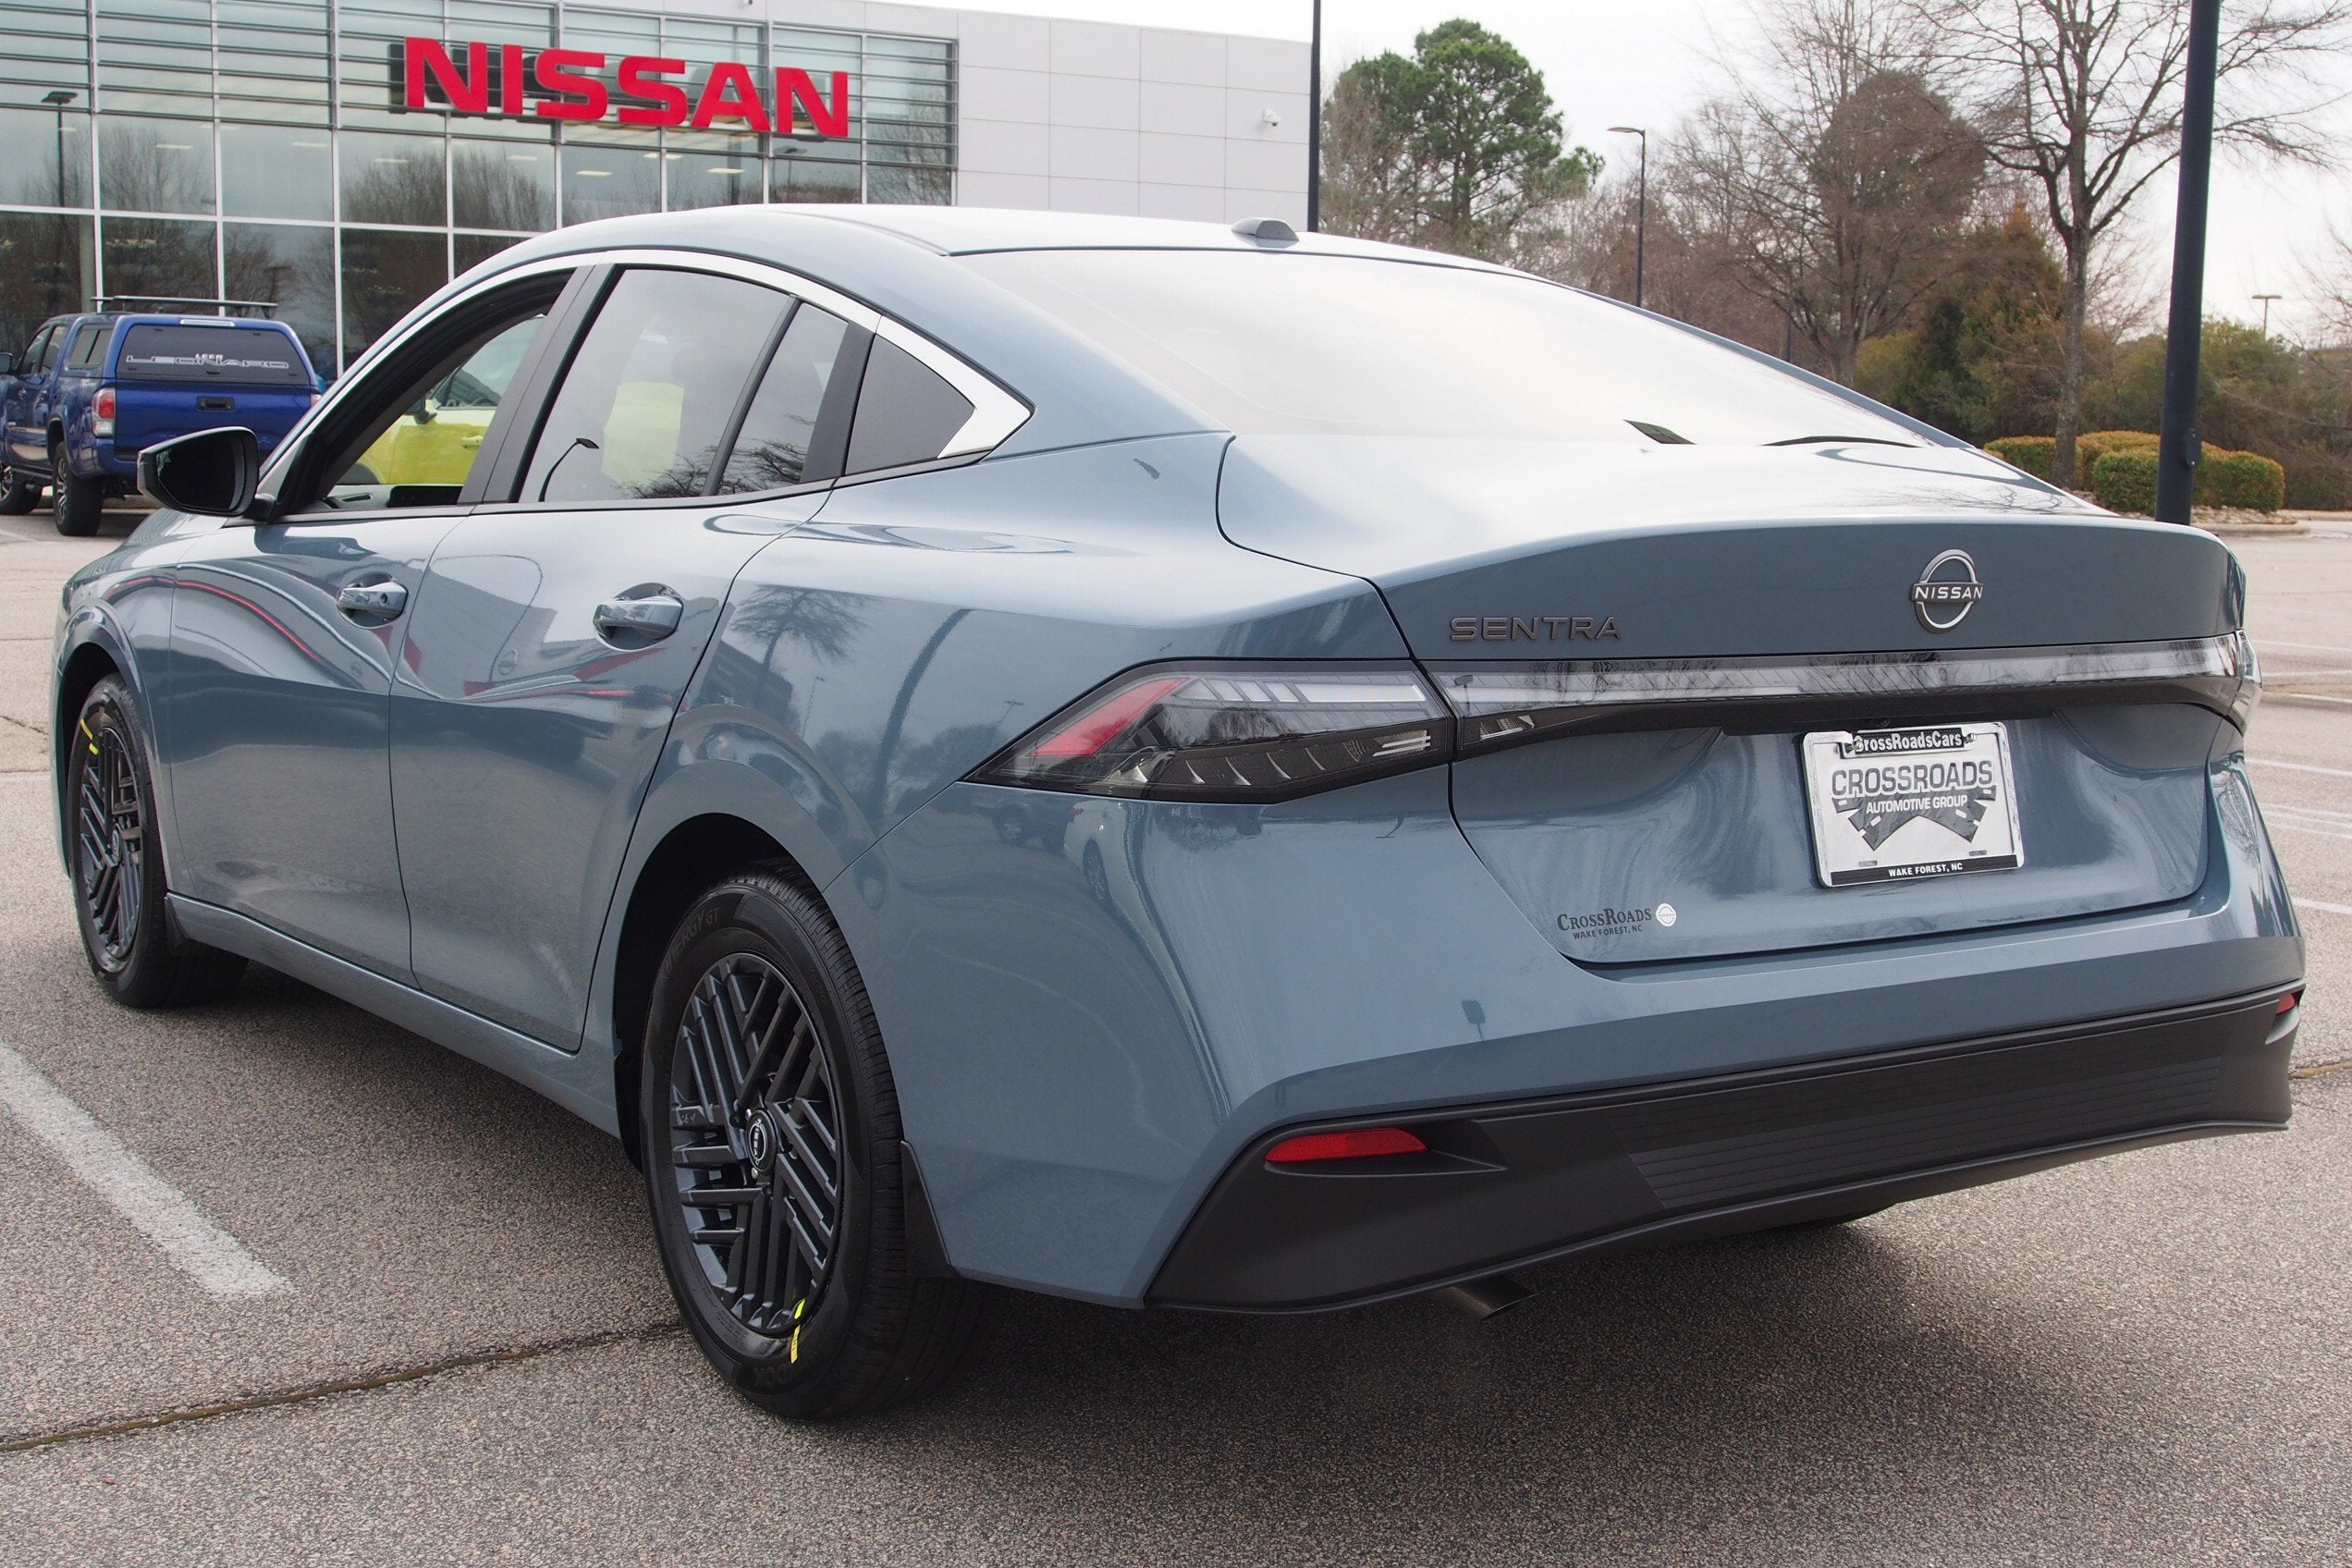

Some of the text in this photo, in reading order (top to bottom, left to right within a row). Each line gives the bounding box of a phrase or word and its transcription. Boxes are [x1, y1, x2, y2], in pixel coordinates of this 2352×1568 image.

[403, 36, 849, 138] NISSAN
[1915, 584, 1983, 600] NISSAN
[1449, 616, 1622, 642] SENTRA
[1855, 730, 1962, 753] CrossRoadsCars
[1831, 760, 1993, 797] CROSSROADS
[1866, 795, 1968, 815] AUTOMOTIVE GROUP
[1889, 862, 1964, 877] WAKE FOREST, NC
[1573, 930, 1597, 939] WAKE
[1599, 926, 1631, 936] FOREST,
